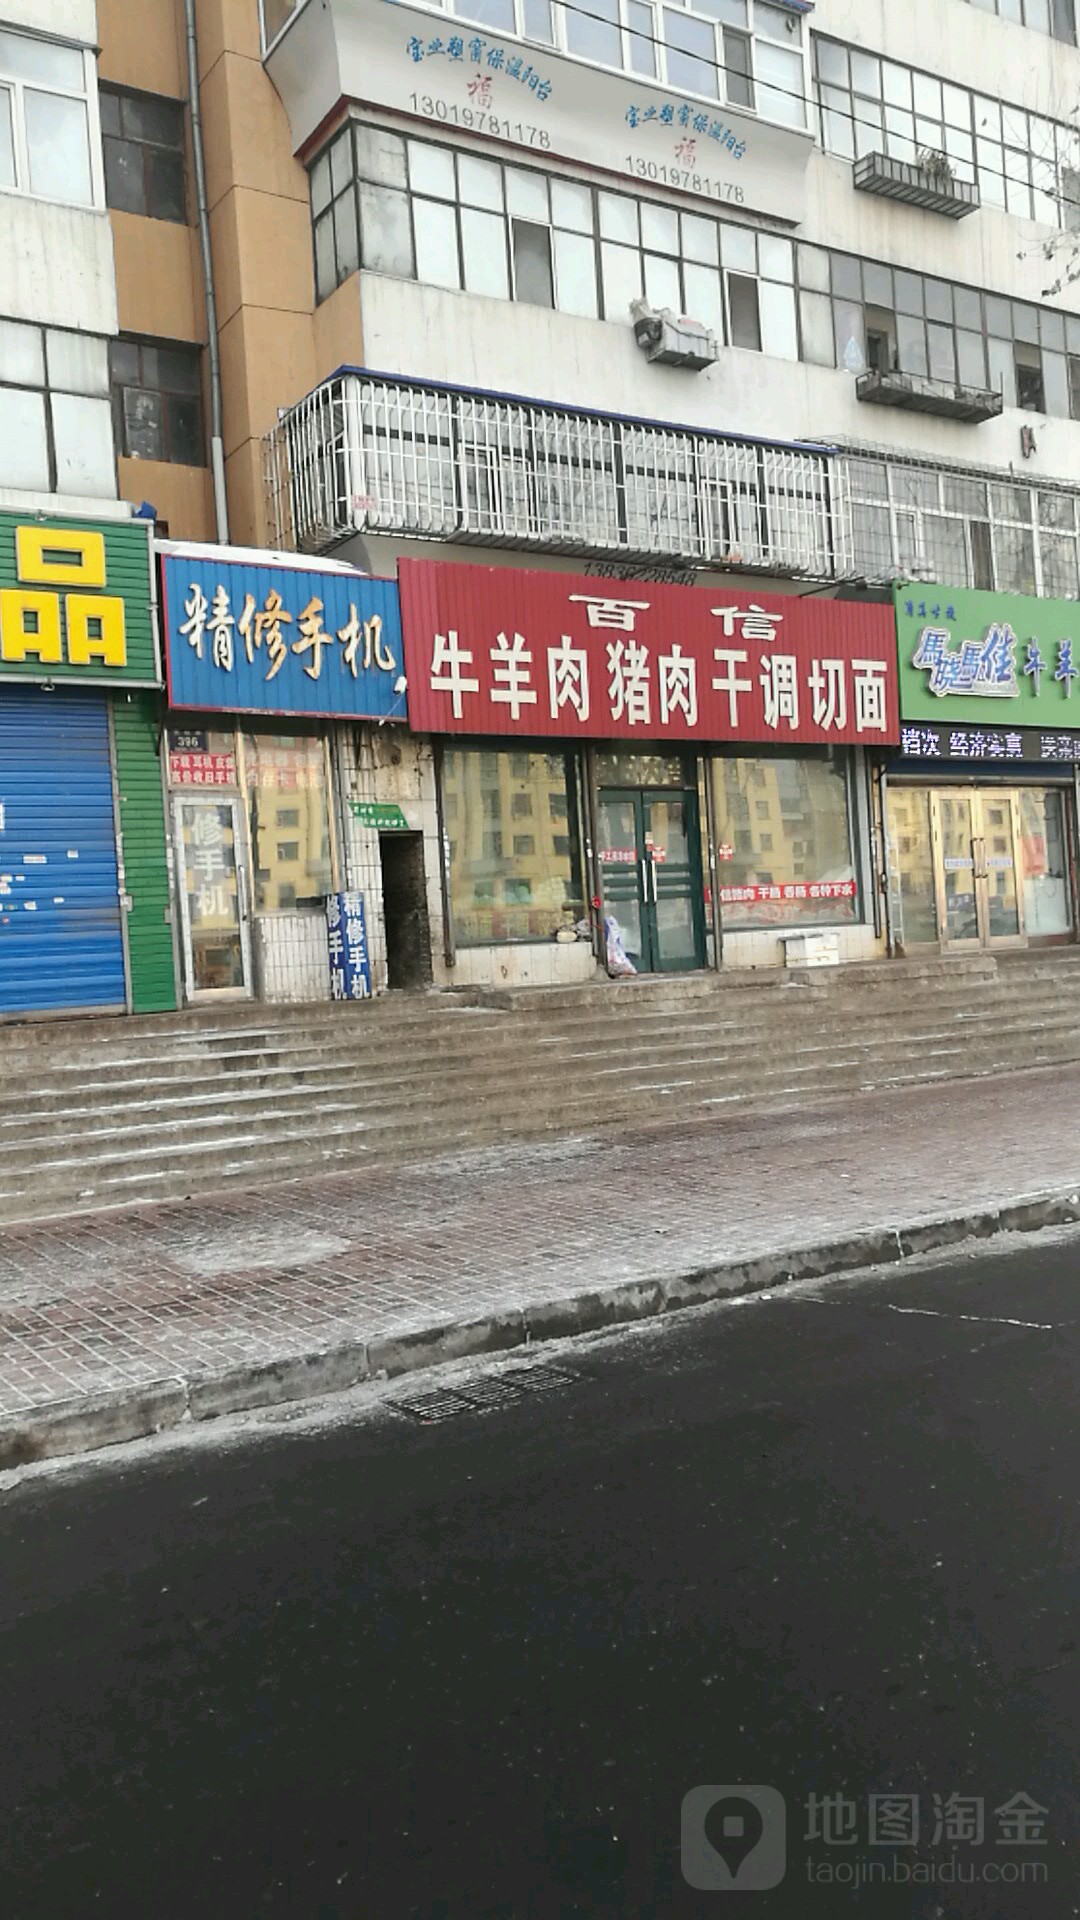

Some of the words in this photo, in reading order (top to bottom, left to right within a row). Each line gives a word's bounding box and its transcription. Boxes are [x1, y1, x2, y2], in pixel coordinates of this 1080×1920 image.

[410, 92, 551, 149] 13019781178
[466, 73, 493, 111] 福
[625, 155, 745, 204] 13019781178
[674, 136, 697, 169] 福
[0, 526, 128, 668] 品
[568, 593, 784, 642] 百信
[179, 582, 398, 681] 精修手机
[430, 630, 888, 734] 牛羊肉猪肉干调切面
[177, 736, 199, 748] 396
[190, 809, 231, 917] 修手机
[343, 891, 370, 1000] 精修手机
